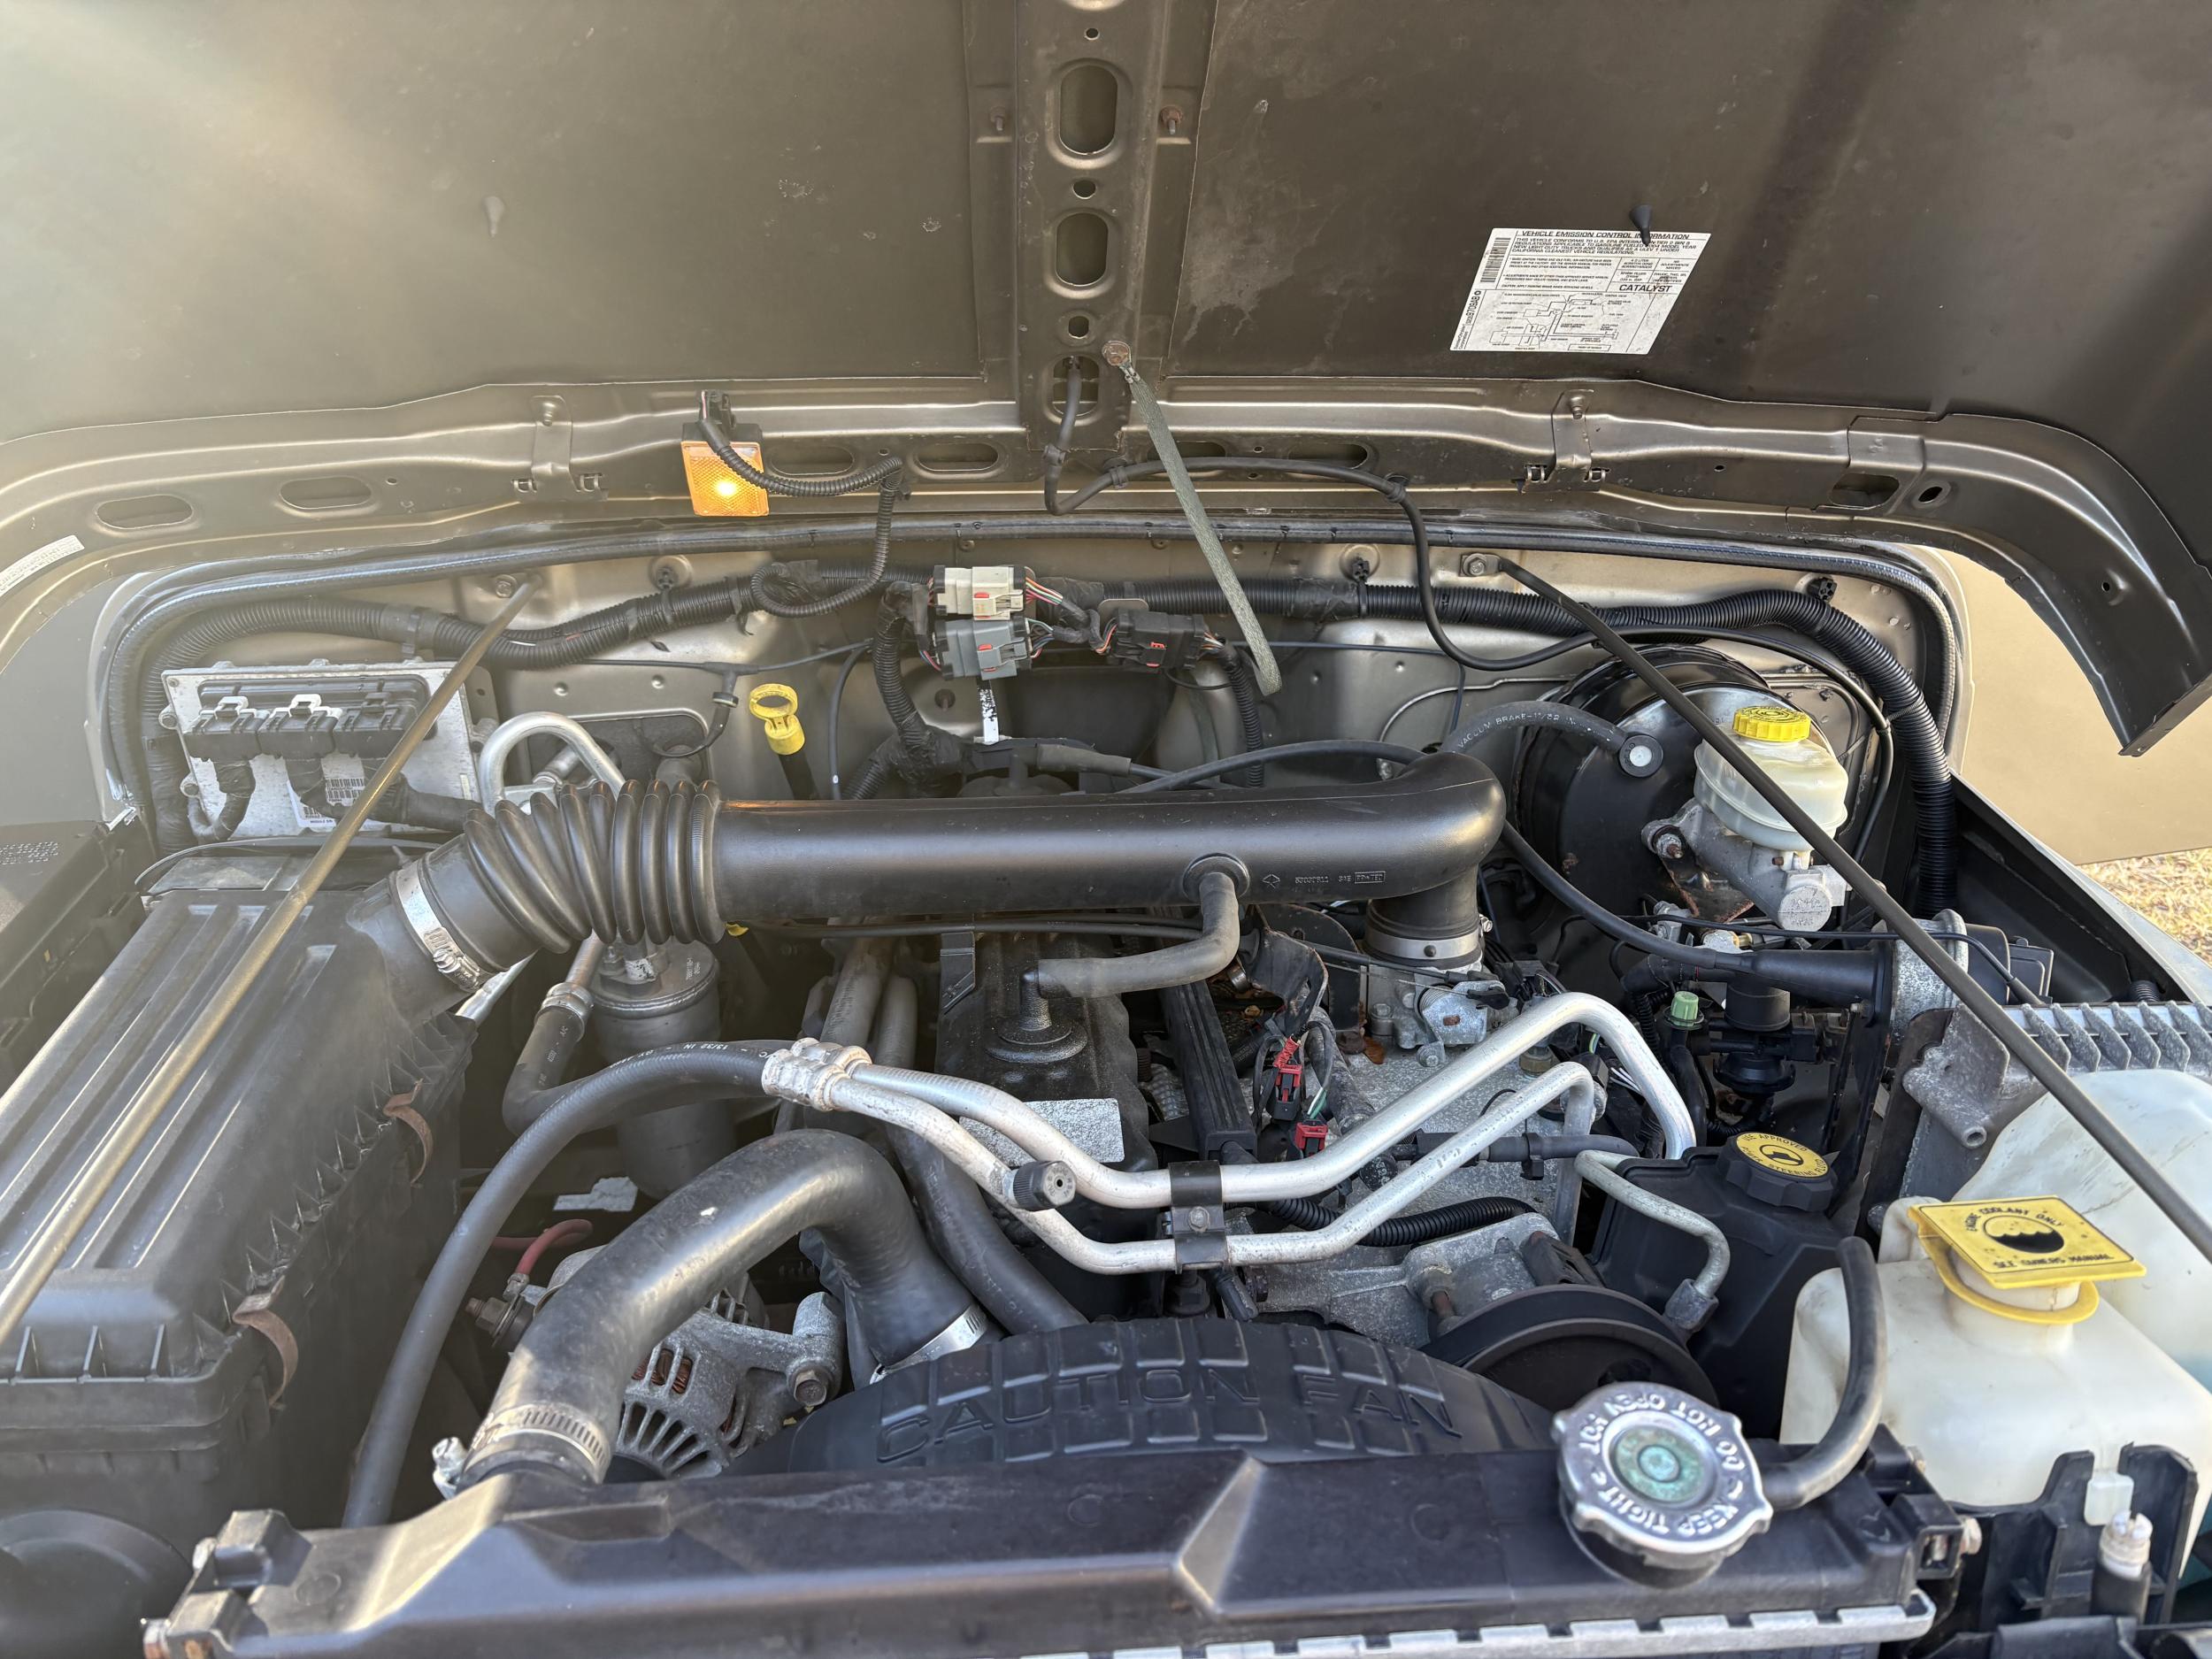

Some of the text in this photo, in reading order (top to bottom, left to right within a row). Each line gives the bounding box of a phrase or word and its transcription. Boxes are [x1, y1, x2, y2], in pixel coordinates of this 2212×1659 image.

[1458, 721, 1491, 748] VACUUM
[1758, 1133, 1809, 1152] APPROVED
[1769, 1164, 1817, 1176] STEERING
[1814, 1158, 1827, 1173] FLUID
[1978, 1207, 2030, 1217] COOLANT
[2035, 1213, 2065, 1227] ONLY
[1993, 1259, 2017, 1269] SEE
[2070, 1253, 2114, 1263] MANUAL
[877, 1368, 1463, 1464] CAUTION FAN
[1578, 1394, 1745, 1471] DO NOT OPEN HOT
[1597, 1486, 1740, 1536] KEEP TIGHT
